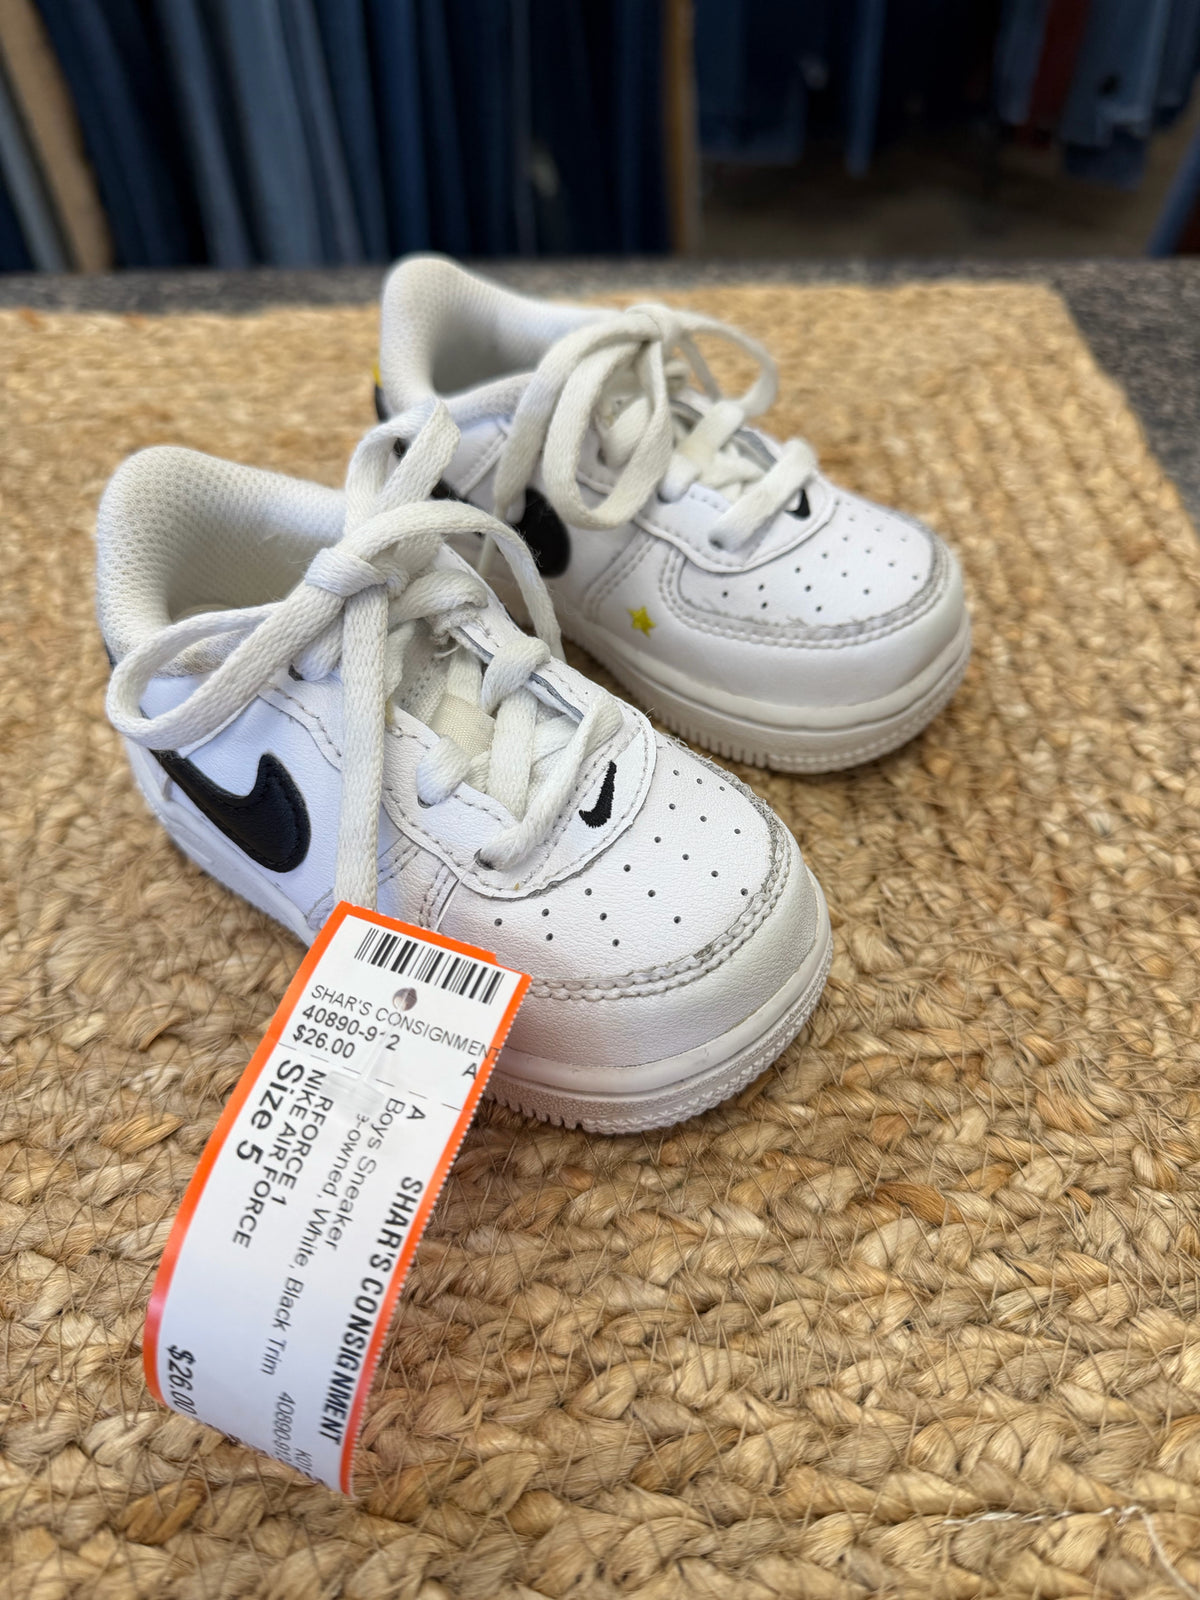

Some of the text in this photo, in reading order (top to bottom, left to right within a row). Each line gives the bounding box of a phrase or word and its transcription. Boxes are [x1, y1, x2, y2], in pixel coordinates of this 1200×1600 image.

[311, 984, 373, 1016] SHAR'S
[293, 1024, 355, 1059] $26.00
[302, 1005, 401, 1051] 40890-92
[462, 1062, 477, 1080] A
[236, 1059, 305, 1165] Size 5
[406, 1105, 426, 1120] A
[232, 1069, 327, 1248] NIKE AIR FORCE
[325, 1098, 406, 1251] Boys Sneaker
[271, 1195, 288, 1206] 1
[289, 1208, 329, 1268] White,
[272, 1277, 304, 1332] Black
[319, 1176, 424, 1446] SHAR'S CONSIGNMENT
[167, 1345, 197, 1415] $26.00
[261, 1337, 287, 1376] Trim
